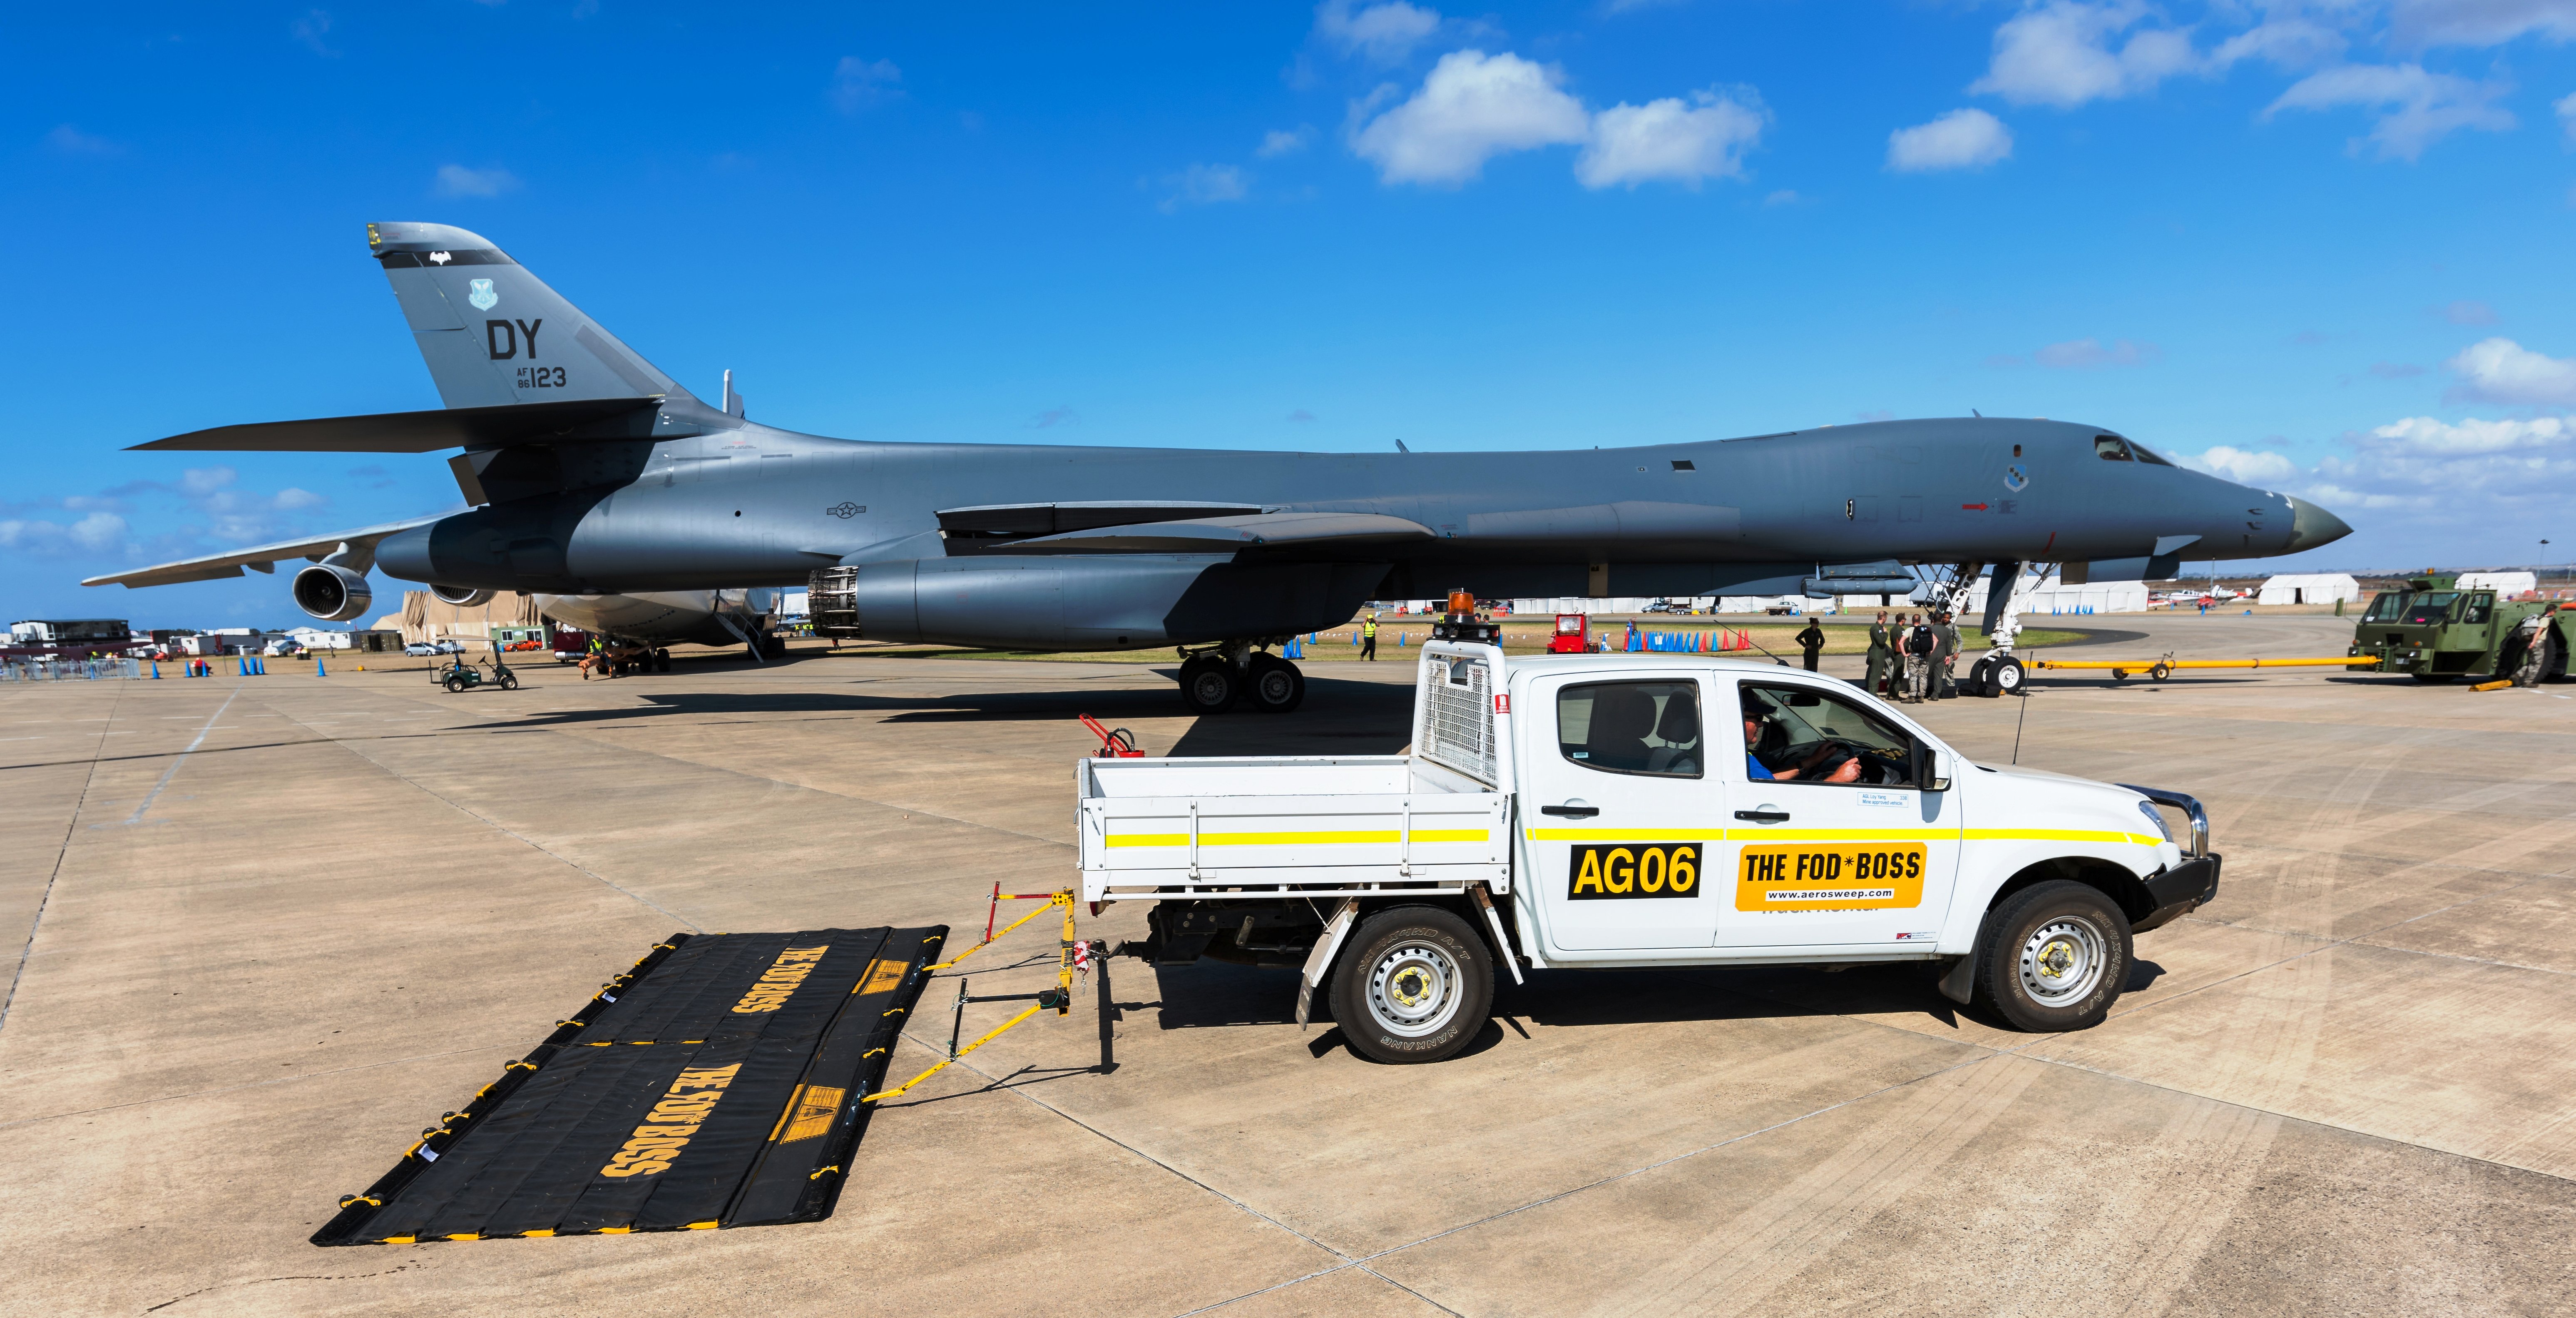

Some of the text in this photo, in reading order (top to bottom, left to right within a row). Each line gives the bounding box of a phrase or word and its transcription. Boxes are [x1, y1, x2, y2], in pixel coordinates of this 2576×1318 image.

[486, 319, 542, 360] DY
[517, 368, 528, 376] AF
[518, 379, 530, 388] 86
[530, 367, 566, 387] 123
[1573, 847, 1696, 893] AG06
[1746, 854, 1787, 881] THE
[1768, 889, 1892, 899] www.aerosweep.com
[2092, 911, 2114, 928] NK
[775, 945, 830, 964] THE
[731, 983, 801, 1013] BOSS
[1380, 1025, 1458, 1050] NANKANG
[669, 1063, 743, 1093] THE
[600, 1124, 701, 1177] BOSS
